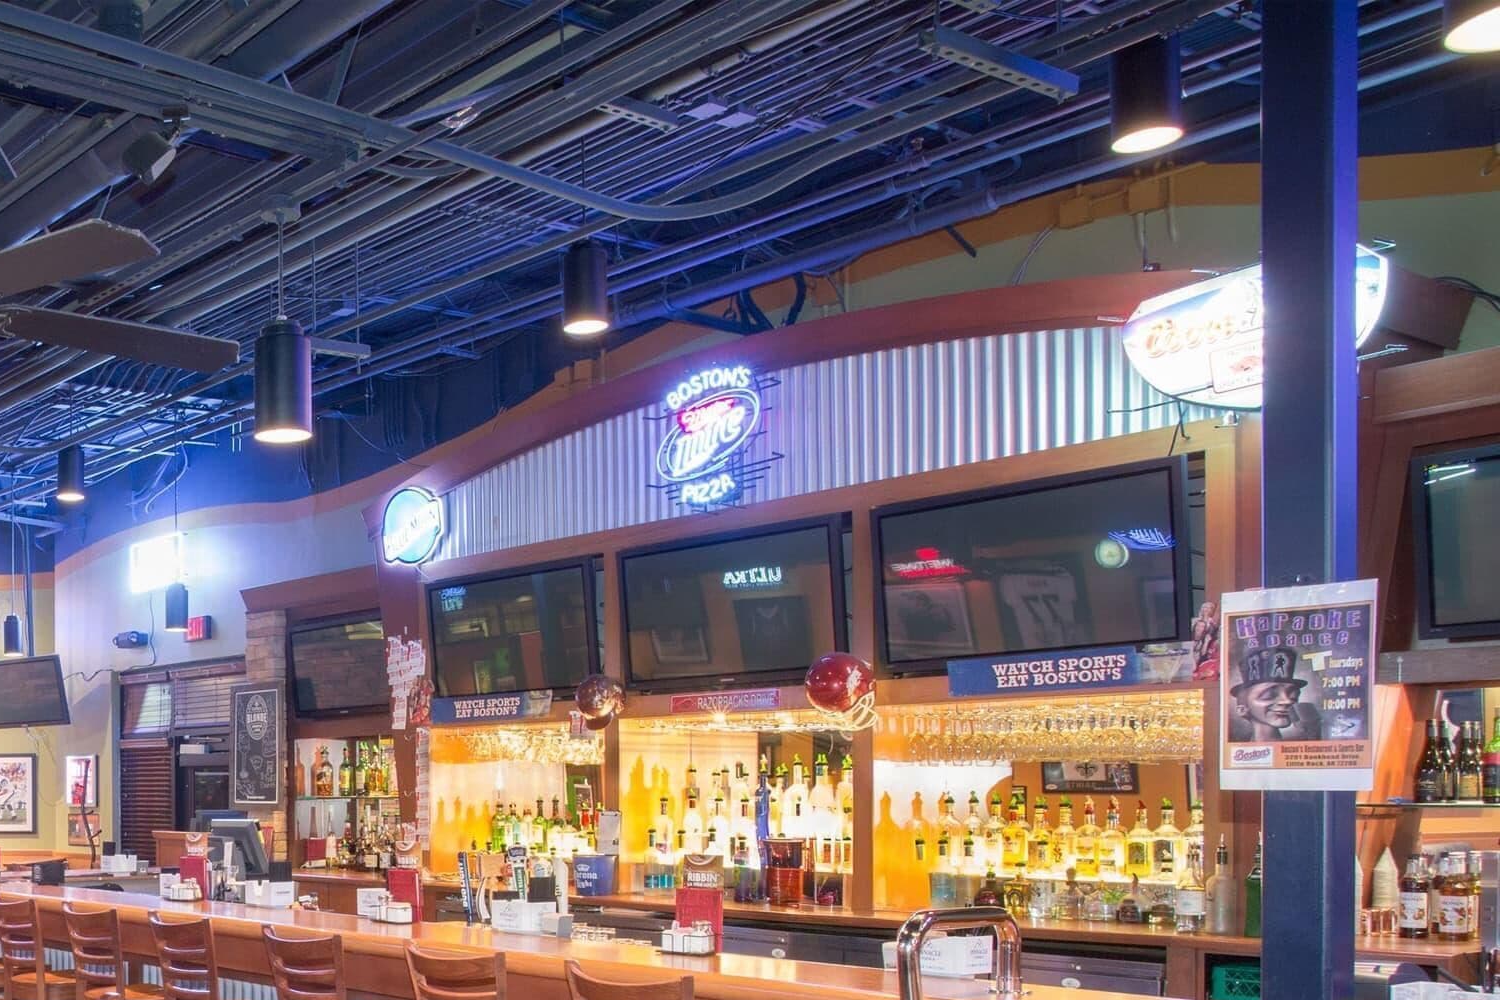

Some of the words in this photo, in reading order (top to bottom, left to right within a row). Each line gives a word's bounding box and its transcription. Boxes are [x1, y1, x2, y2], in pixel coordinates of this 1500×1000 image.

[666, 365, 751, 410] BOSTON'S
[681, 474, 736, 503] PIZZA
[991, 659, 1055, 677] WATCH
[1058, 653, 1127, 673] SPORTS
[1302, 650, 1364, 672] Thursdays
[995, 675, 1028, 689] EAT
[1032, 667, 1123, 686] BOSTON'S
[1322, 677, 1343, 688] 7:00
[1345, 675, 1361, 687] PM
[453, 699, 485, 710] WATCH
[486, 696, 521, 708] SPORTS
[698, 694, 749, 710] RAZORBACKS
[751, 691, 775, 707] DRIVE
[1323, 699, 1345, 710] 10:00
[1347, 698, 1361, 709] PM
[455, 708, 472, 718] EAT
[473, 705, 518, 717] BOSTON'S
[574, 872, 598, 880] orona
